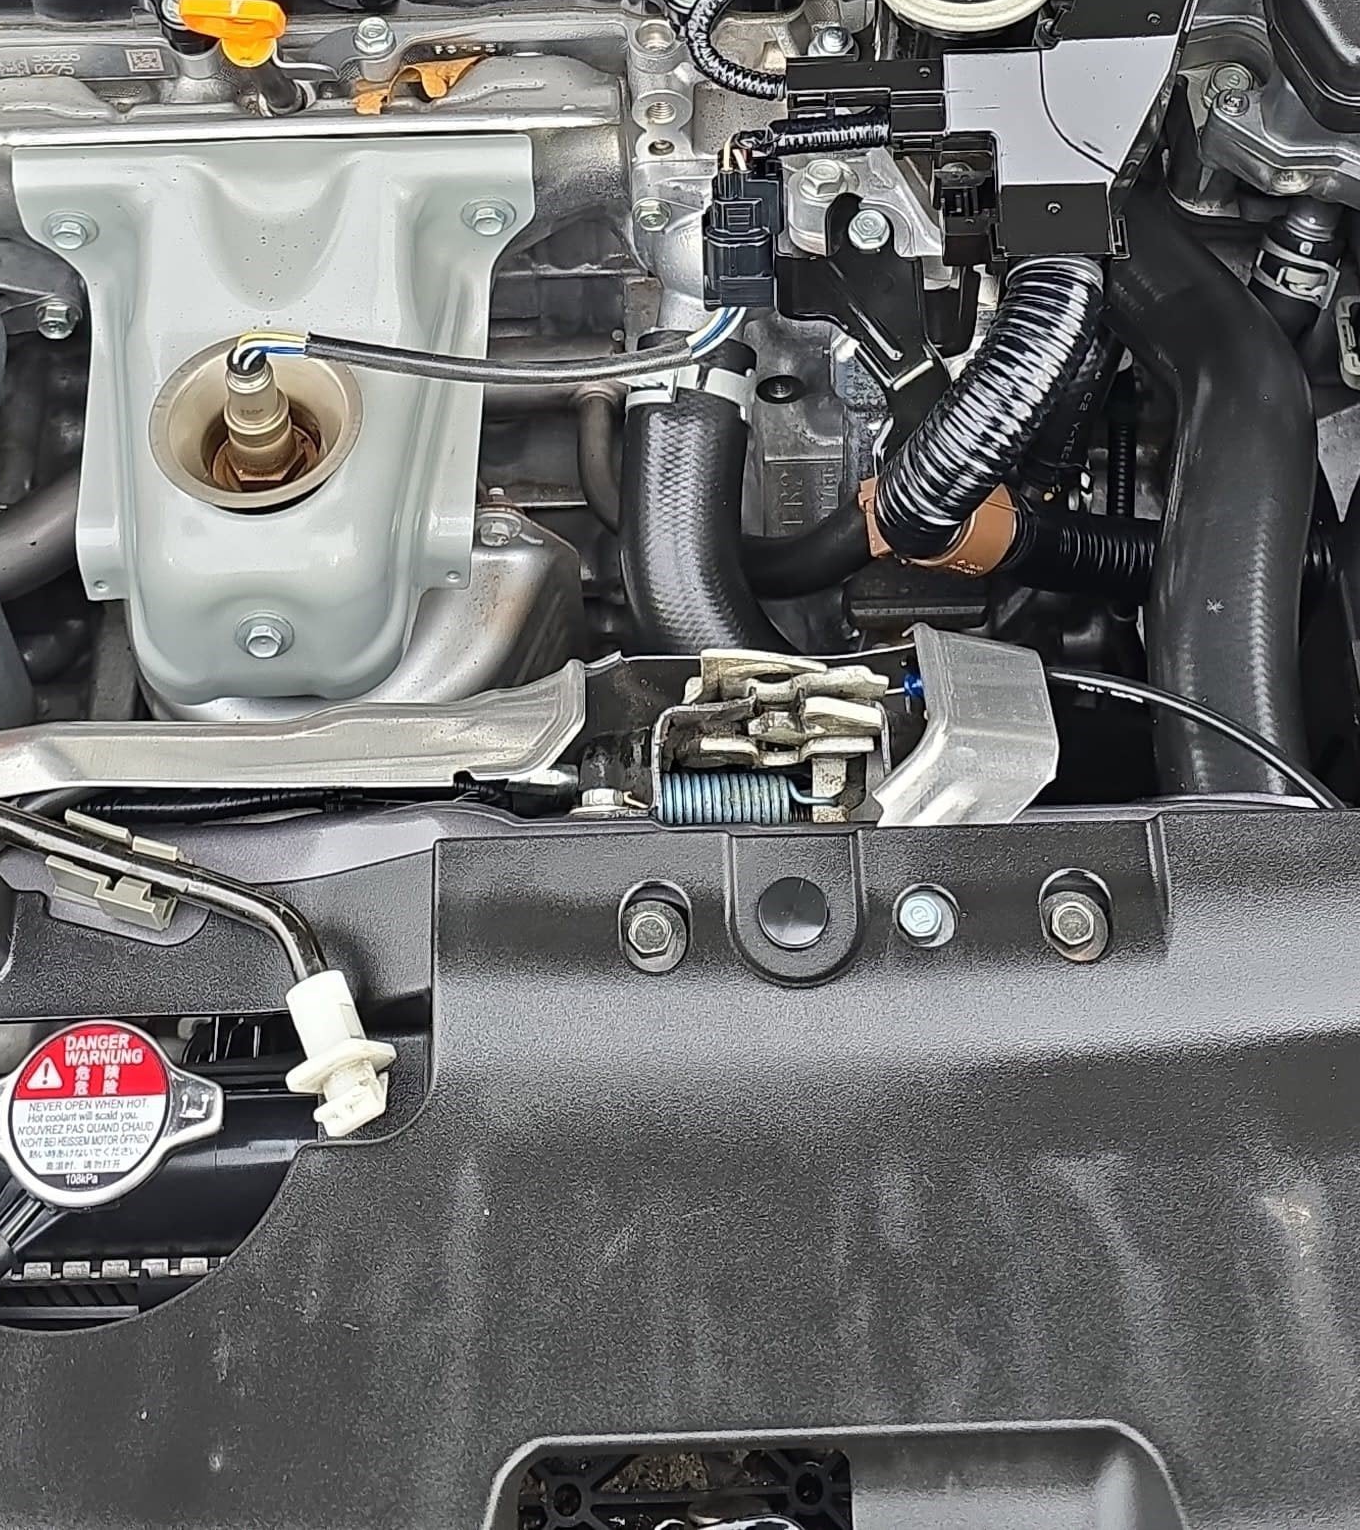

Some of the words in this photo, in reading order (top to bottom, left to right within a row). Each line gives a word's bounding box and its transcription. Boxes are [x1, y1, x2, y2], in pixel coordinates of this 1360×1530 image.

[65, 1033, 130, 1050] DANGER
[64, 1048, 143, 1066] WARNUNG
[29, 1100, 63, 1112] NEVER
[64, 1099, 93, 1111] OPEN
[94, 1098, 125, 1110] WHEN
[27, 1112, 44, 1123] Hot
[45, 1111, 77, 1123] coolant
[78, 1110, 93, 1121] will
[95, 1110, 118, 1121] scald
[17, 1123, 65, 1136] N'OUVREZ
[66, 1123, 85, 1135] PAS
[86, 1122, 120, 1134] QUAND
[121, 1121, 154, 1133] CHAUD
